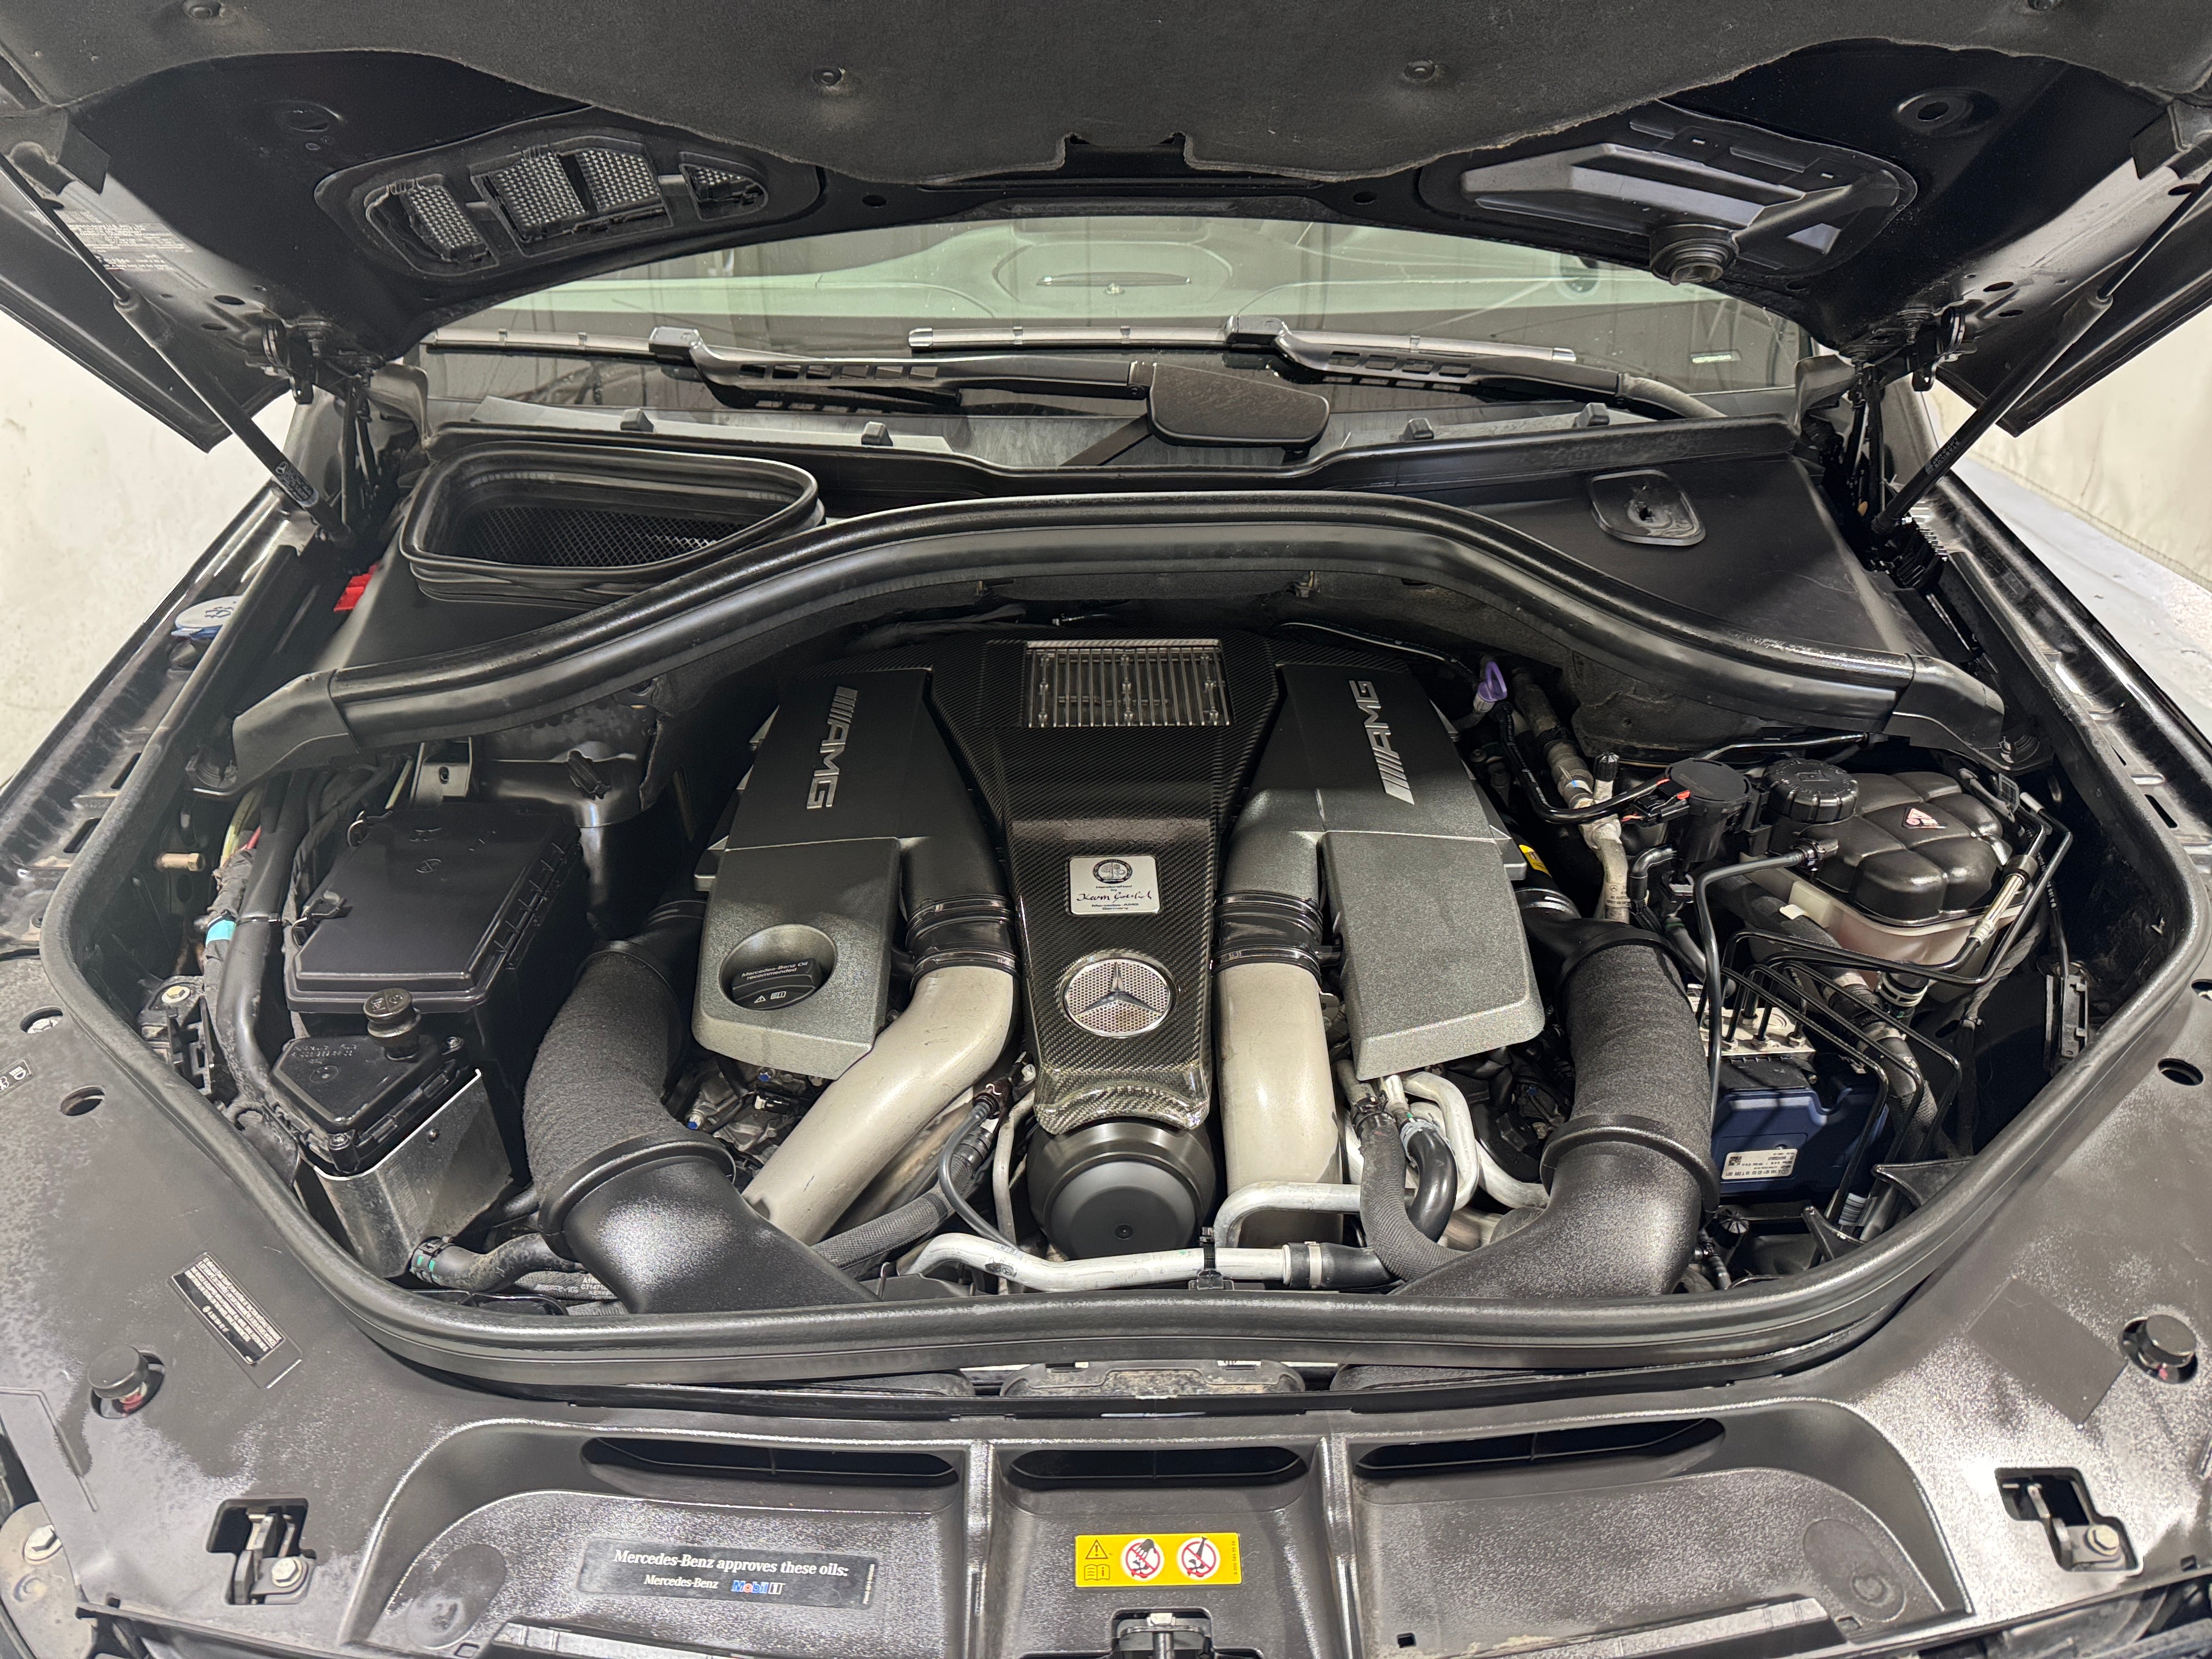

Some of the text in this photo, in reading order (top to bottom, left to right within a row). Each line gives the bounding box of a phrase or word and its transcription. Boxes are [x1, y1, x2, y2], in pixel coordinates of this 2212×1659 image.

[1348, 680, 1401, 763] AMG
[806, 716, 851, 809] AMG
[741, 964, 797, 977] Mercedes-Benz
[747, 967, 797, 980] recommended
[613, 1549, 849, 1577] Mercedes-Benz approves these oils:
[643, 1574, 719, 1589] Mercedes-Benz
[731, 1579, 769, 1594] Mobil
